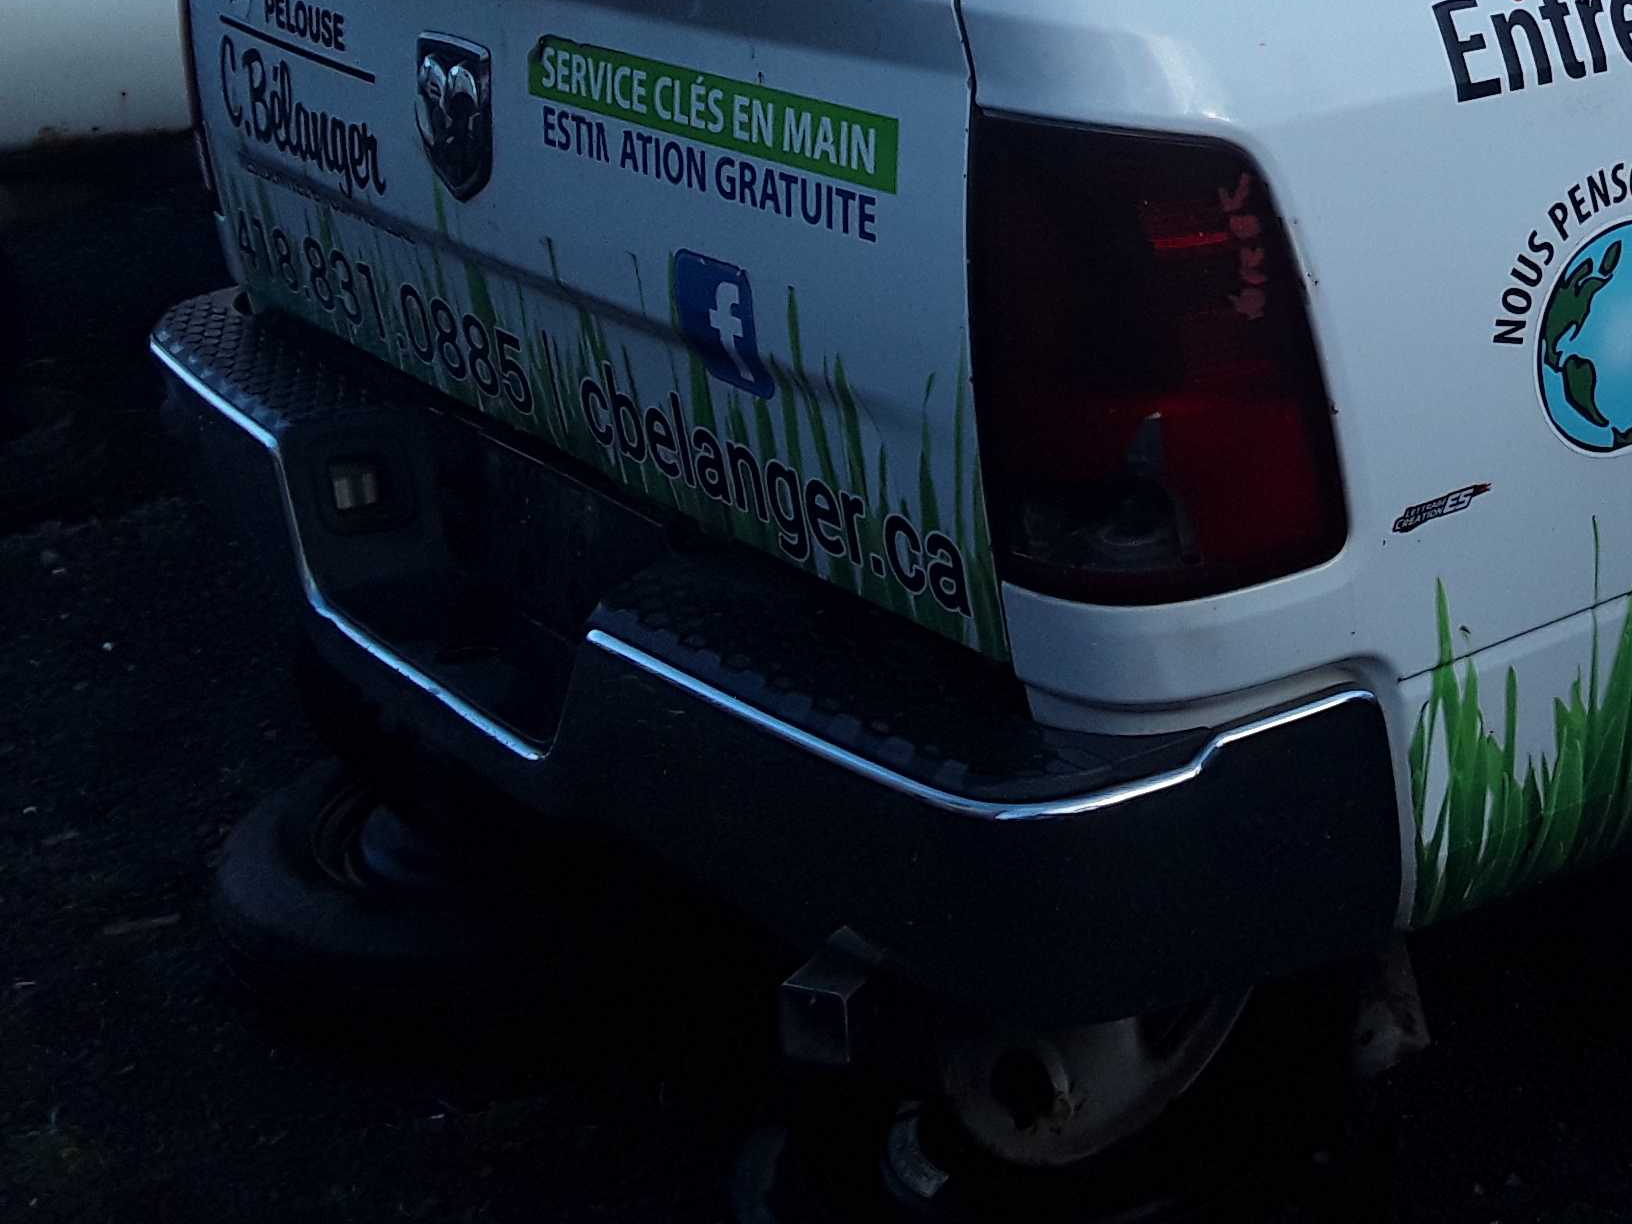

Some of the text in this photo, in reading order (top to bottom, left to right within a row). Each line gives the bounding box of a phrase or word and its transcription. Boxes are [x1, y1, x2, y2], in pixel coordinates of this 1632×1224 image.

[541, 47, 876, 174] SERVICE CLÉS EN MAIN
[715, 156, 877, 242] GRATUITE
[1493, 230, 1555, 345] NOUS
[238, 208, 534, 414] 418.831.0885
[580, 360, 973, 617] cbelanger.ca
